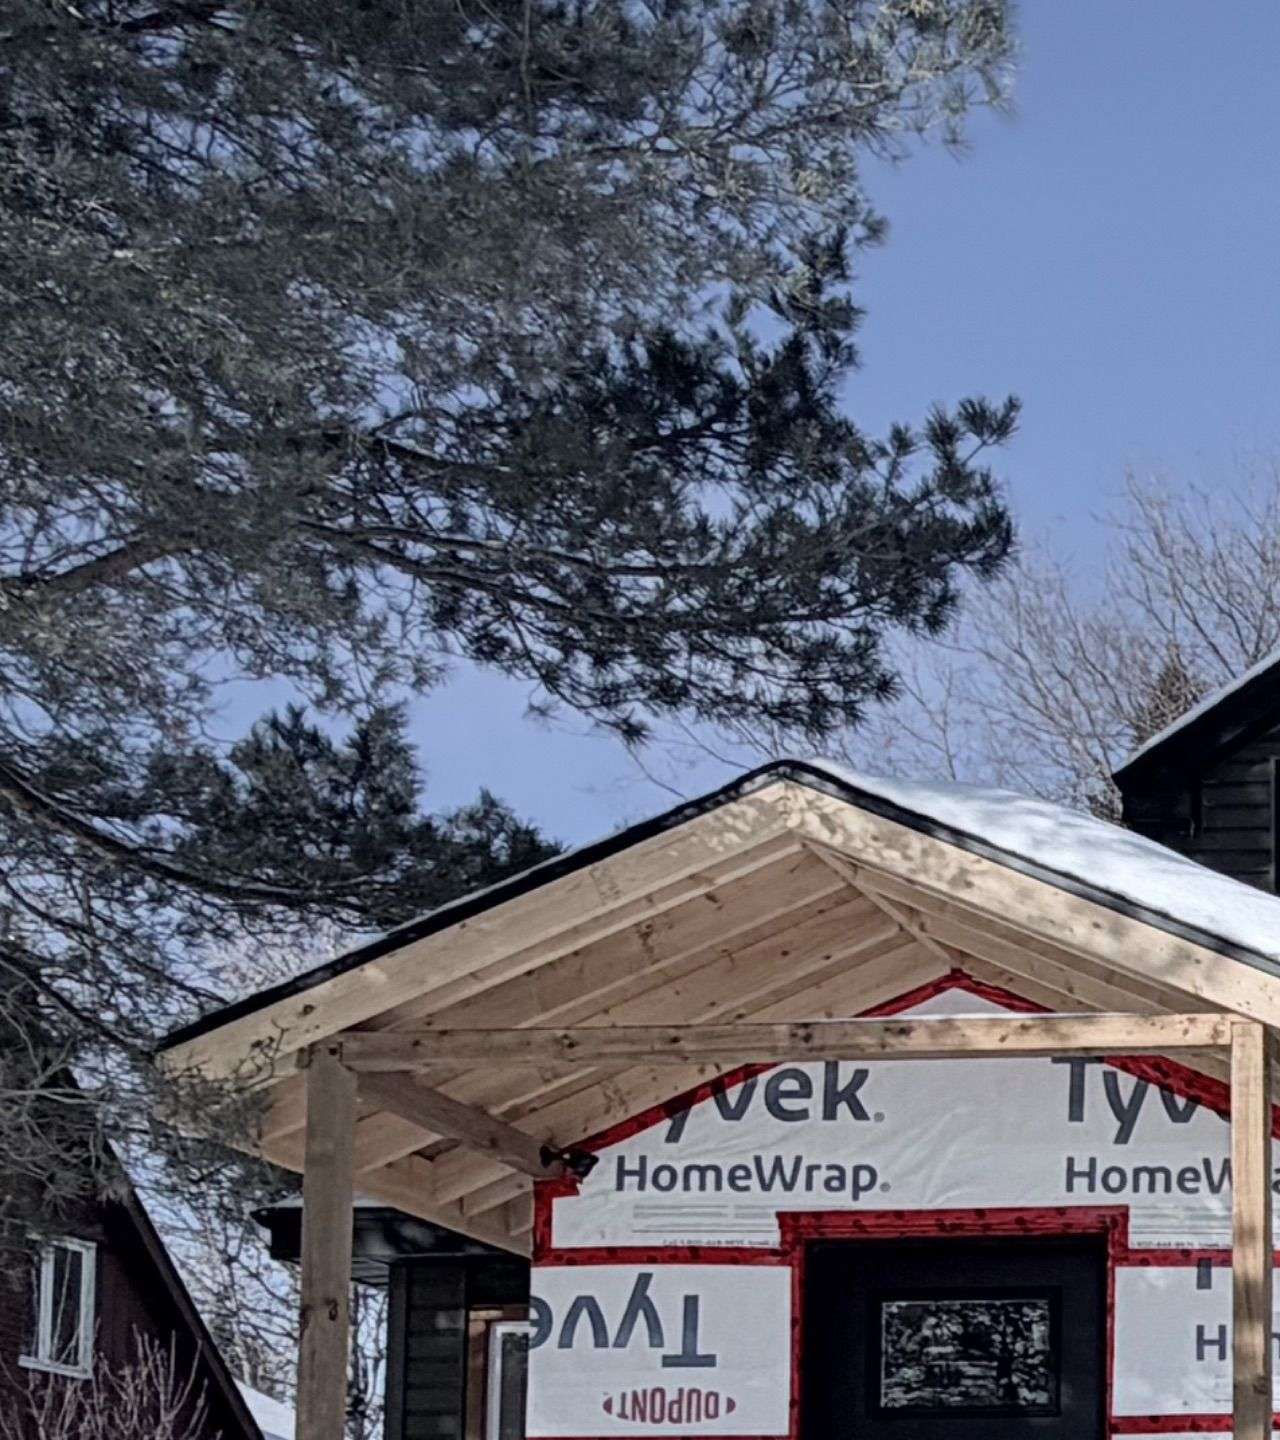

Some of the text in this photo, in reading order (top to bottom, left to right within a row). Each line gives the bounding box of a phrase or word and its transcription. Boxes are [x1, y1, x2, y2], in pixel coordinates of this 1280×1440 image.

[1051, 1056, 1231, 1144] Tyv
[615, 1154, 878, 1201] HomeWrap
[616, 1386, 720, 1425] DUPONT
